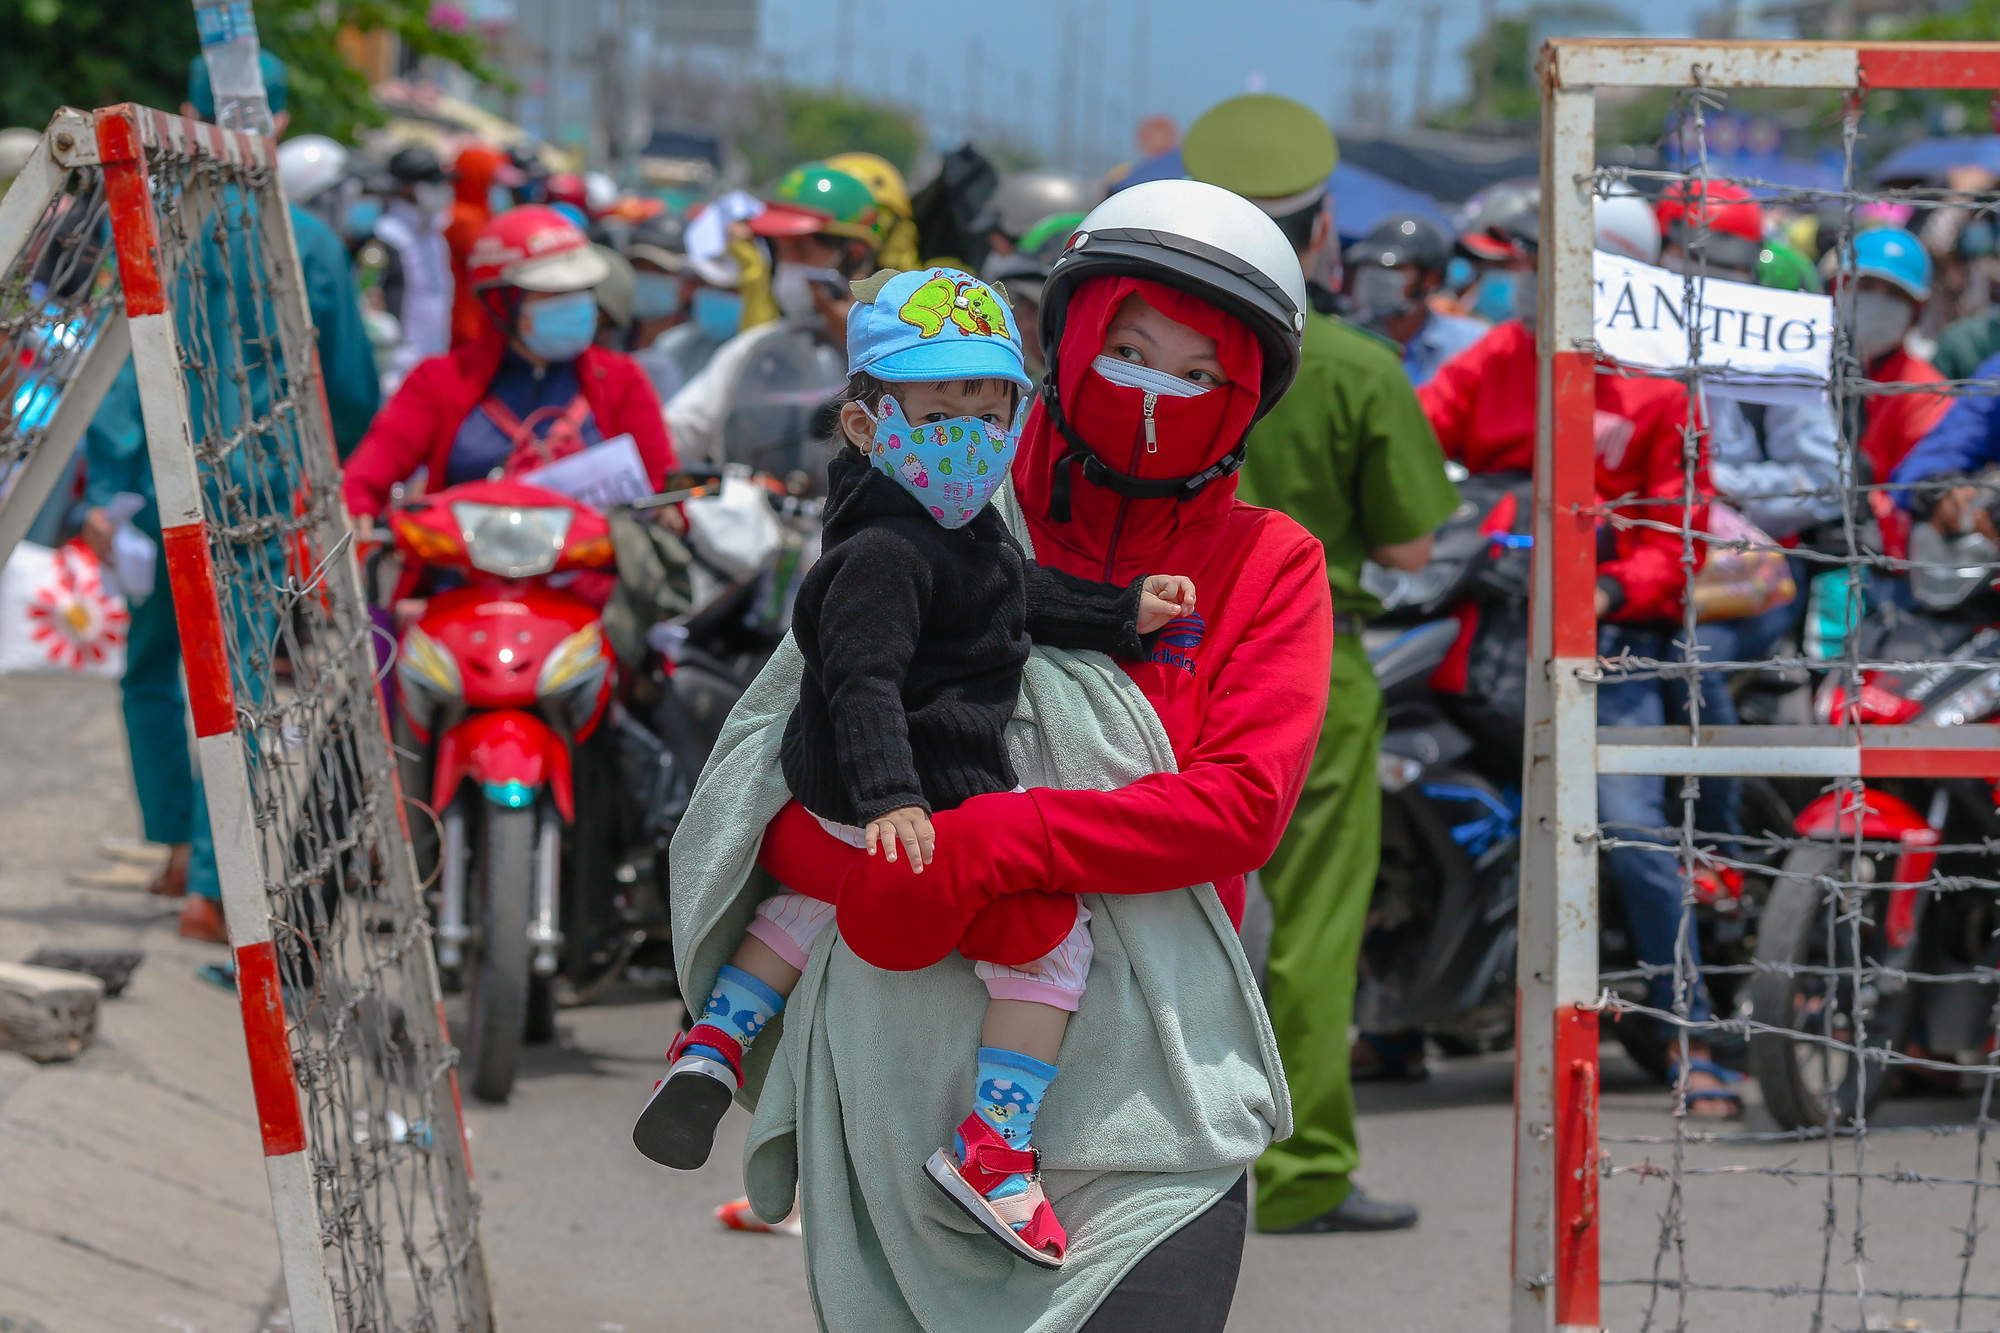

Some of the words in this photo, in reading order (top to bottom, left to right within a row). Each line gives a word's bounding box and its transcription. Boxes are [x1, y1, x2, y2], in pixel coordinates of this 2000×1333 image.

[1594, 268, 1690, 331] ẦN
[1704, 302, 1817, 354] THƠ
[953, 481, 964, 508] Hello
